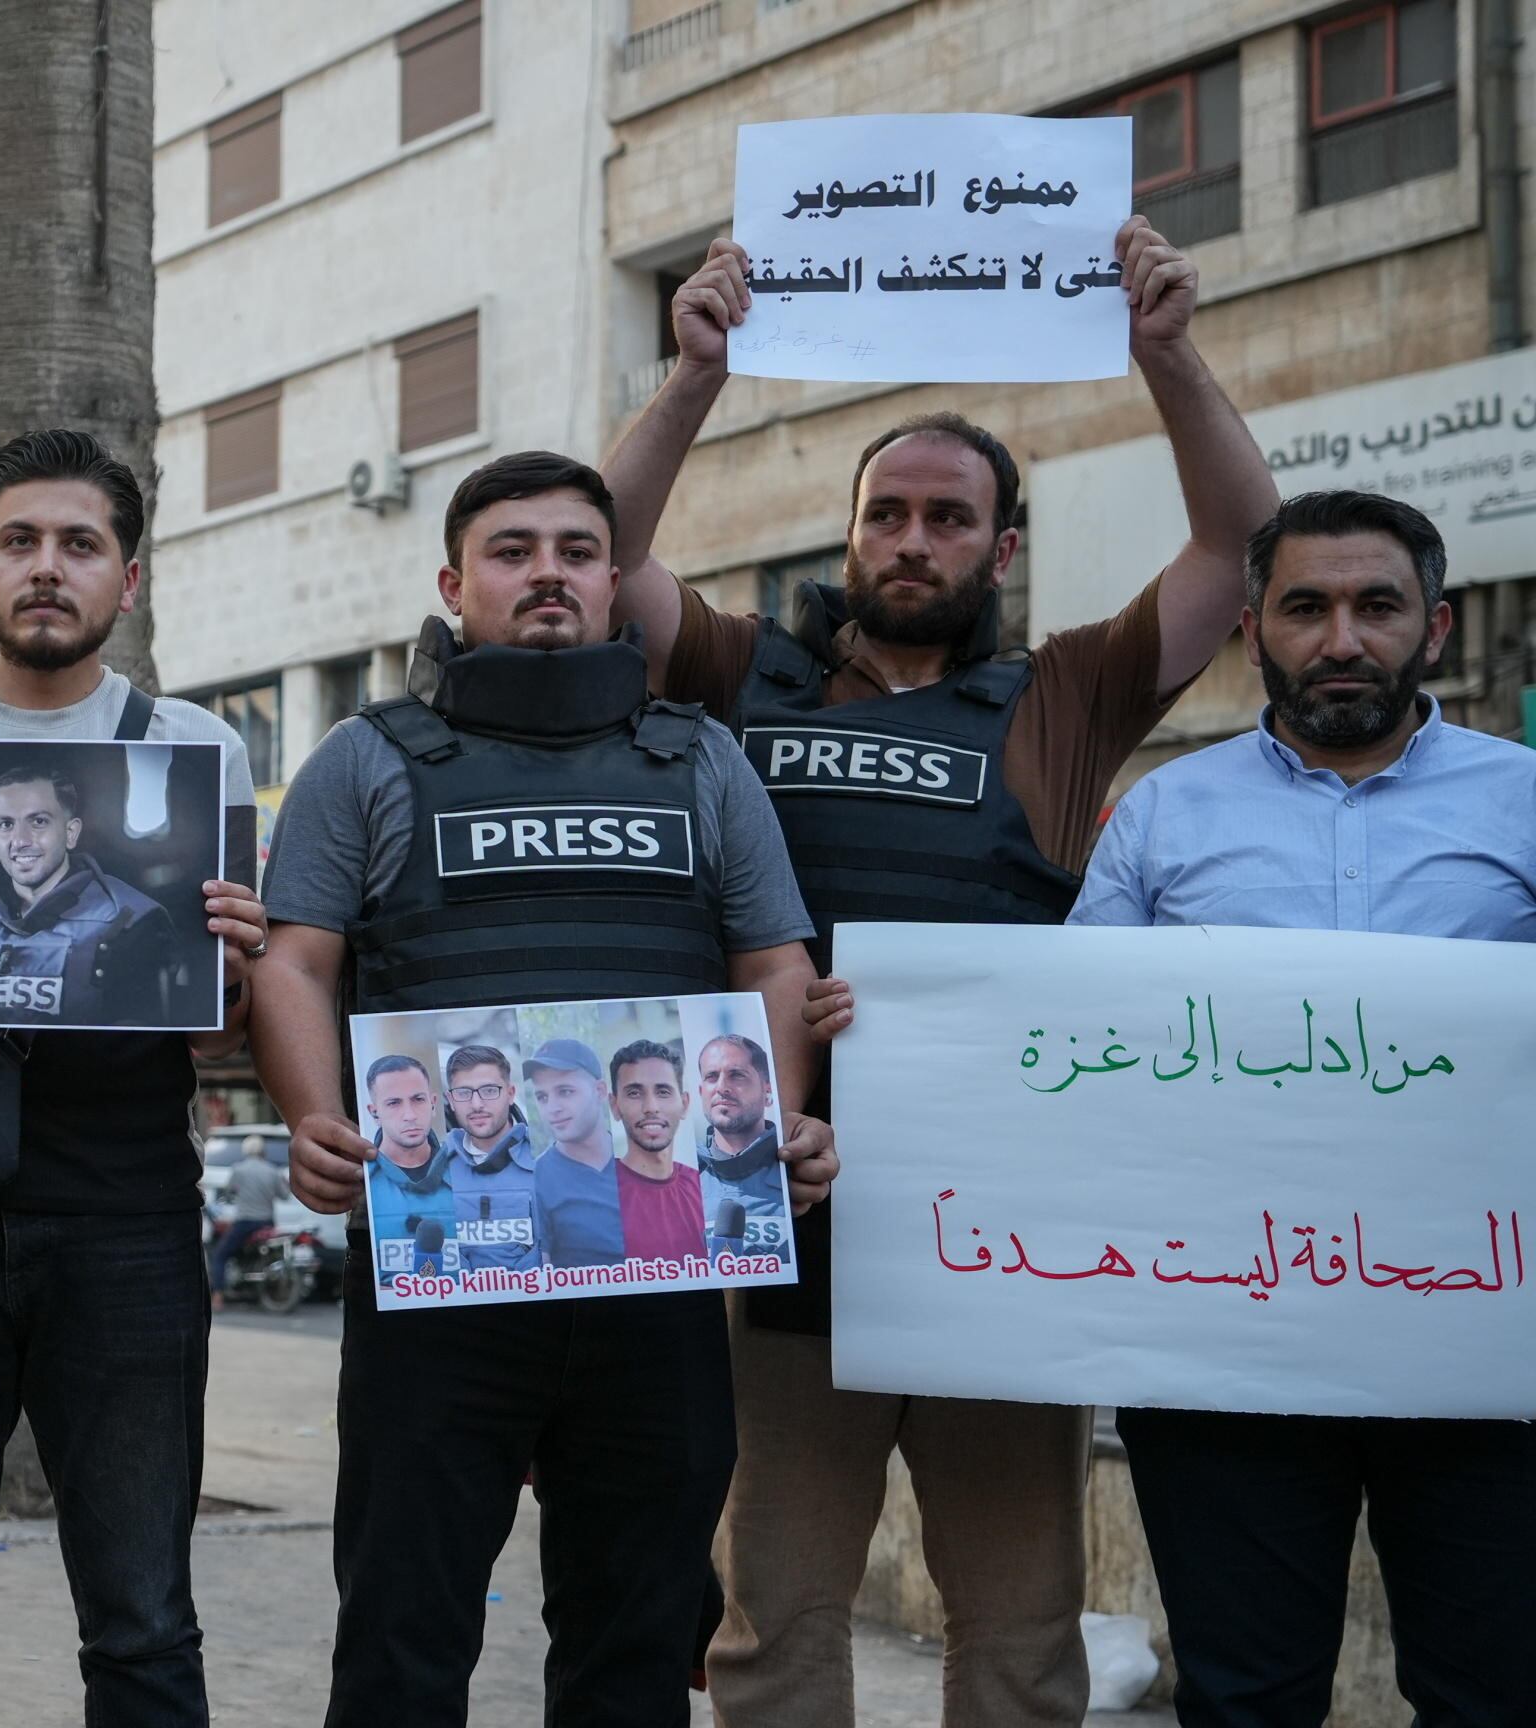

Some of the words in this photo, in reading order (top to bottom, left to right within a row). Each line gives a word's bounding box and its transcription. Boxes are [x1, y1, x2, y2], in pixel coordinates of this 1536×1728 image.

[782, 169, 935, 220] التصوير
[963, 170, 1079, 215] ممنوع
[743, 255, 863, 302] الحقيقة
[877, 253, 1007, 292] تنكشف
[1021, 251, 1043, 290] لا
[1054, 255, 1124, 298] حتى
[1360, 391, 1502, 461] للتدريب
[1267, 430, 1351, 470] والتم
[1422, 452, 1514, 487] training
[769, 738, 952, 790] PRESS
[470, 817, 661, 862] PRESS
[1019, 1027, 1141, 1094] غزة
[1236, 998, 1370, 1088] ادلب
[1372, 1042, 1456, 1095] من
[394, 1275, 455, 1300] Stop
[461, 1268, 541, 1295] killing
[545, 1260, 680, 1293] journalists
[687, 1256, 710, 1279] in
[717, 1253, 781, 1277] Gaza
[1152, 1208, 1281, 1301] ليست
[1289, 1210, 1524, 1297] الصحافة
